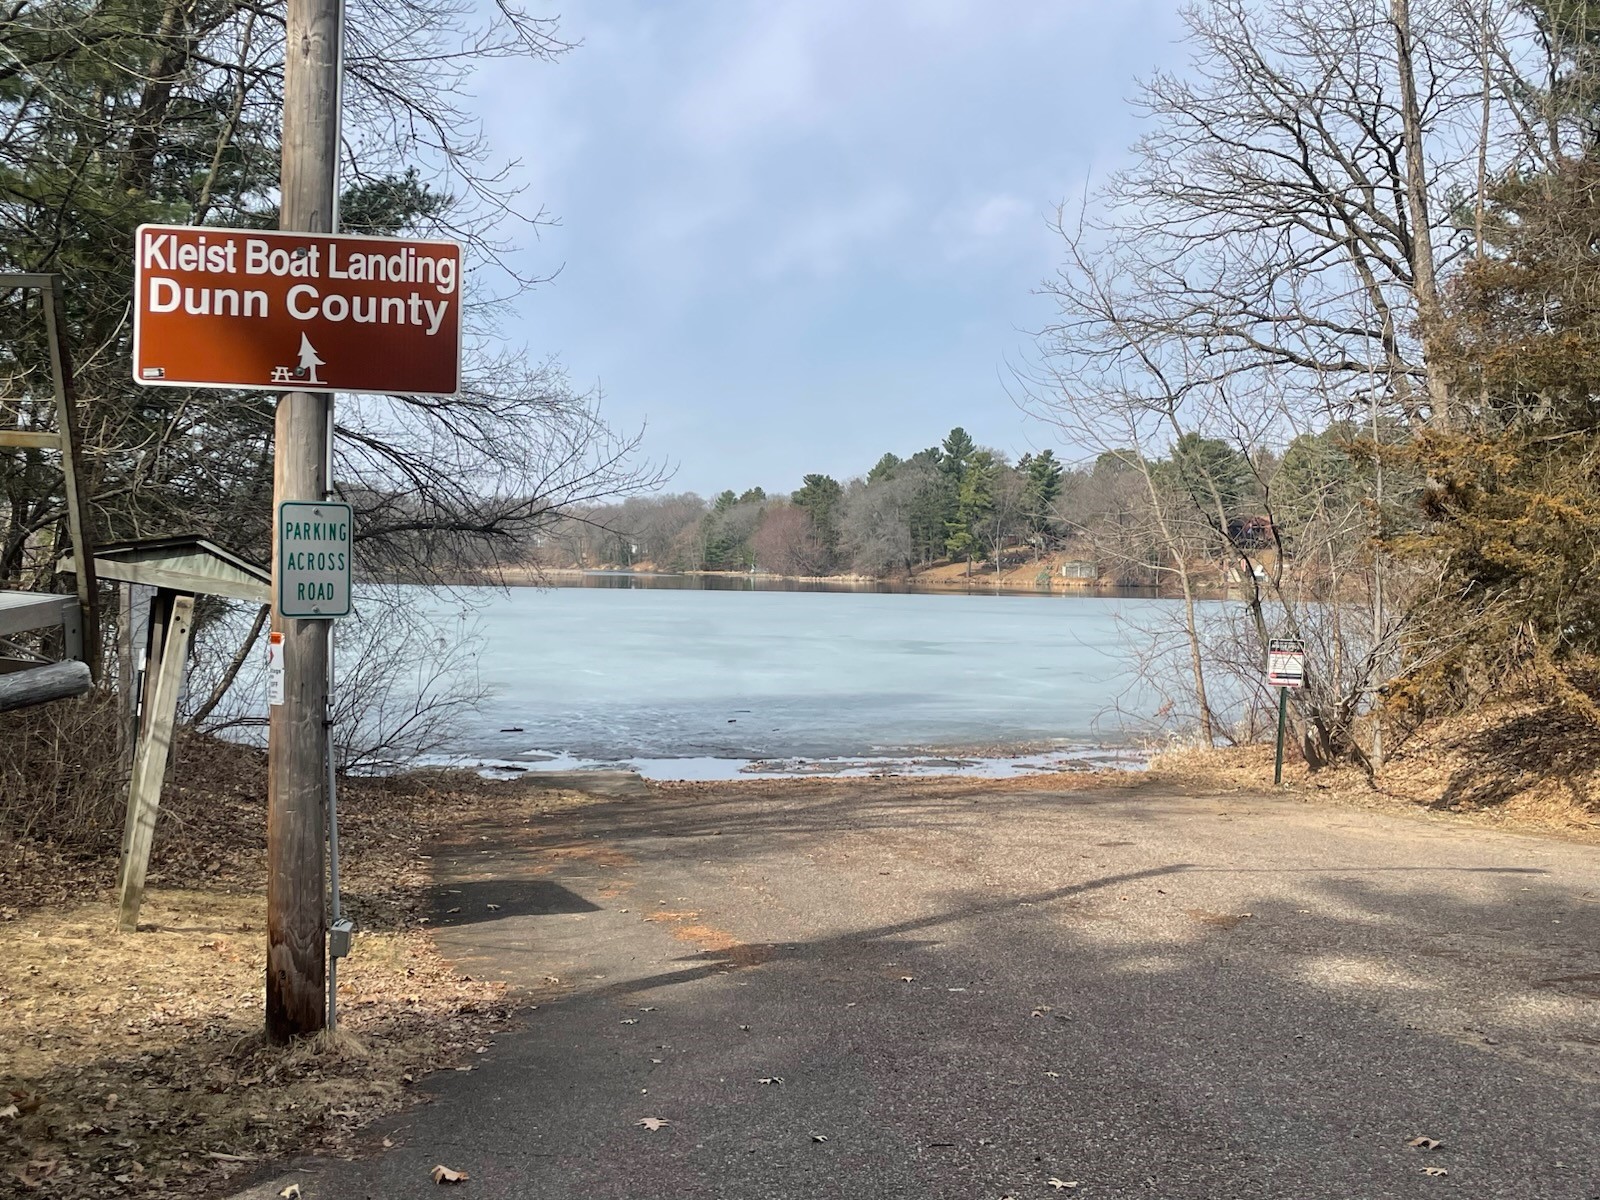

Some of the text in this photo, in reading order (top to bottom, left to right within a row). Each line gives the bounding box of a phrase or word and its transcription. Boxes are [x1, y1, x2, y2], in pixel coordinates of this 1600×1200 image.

[144, 233, 456, 294] Kleist Boat Landing
[149, 277, 449, 336] Dunn County
[286, 522, 347, 541] PARKING
[287, 552, 345, 571] ACROSS
[297, 582, 334, 601] ROAD
